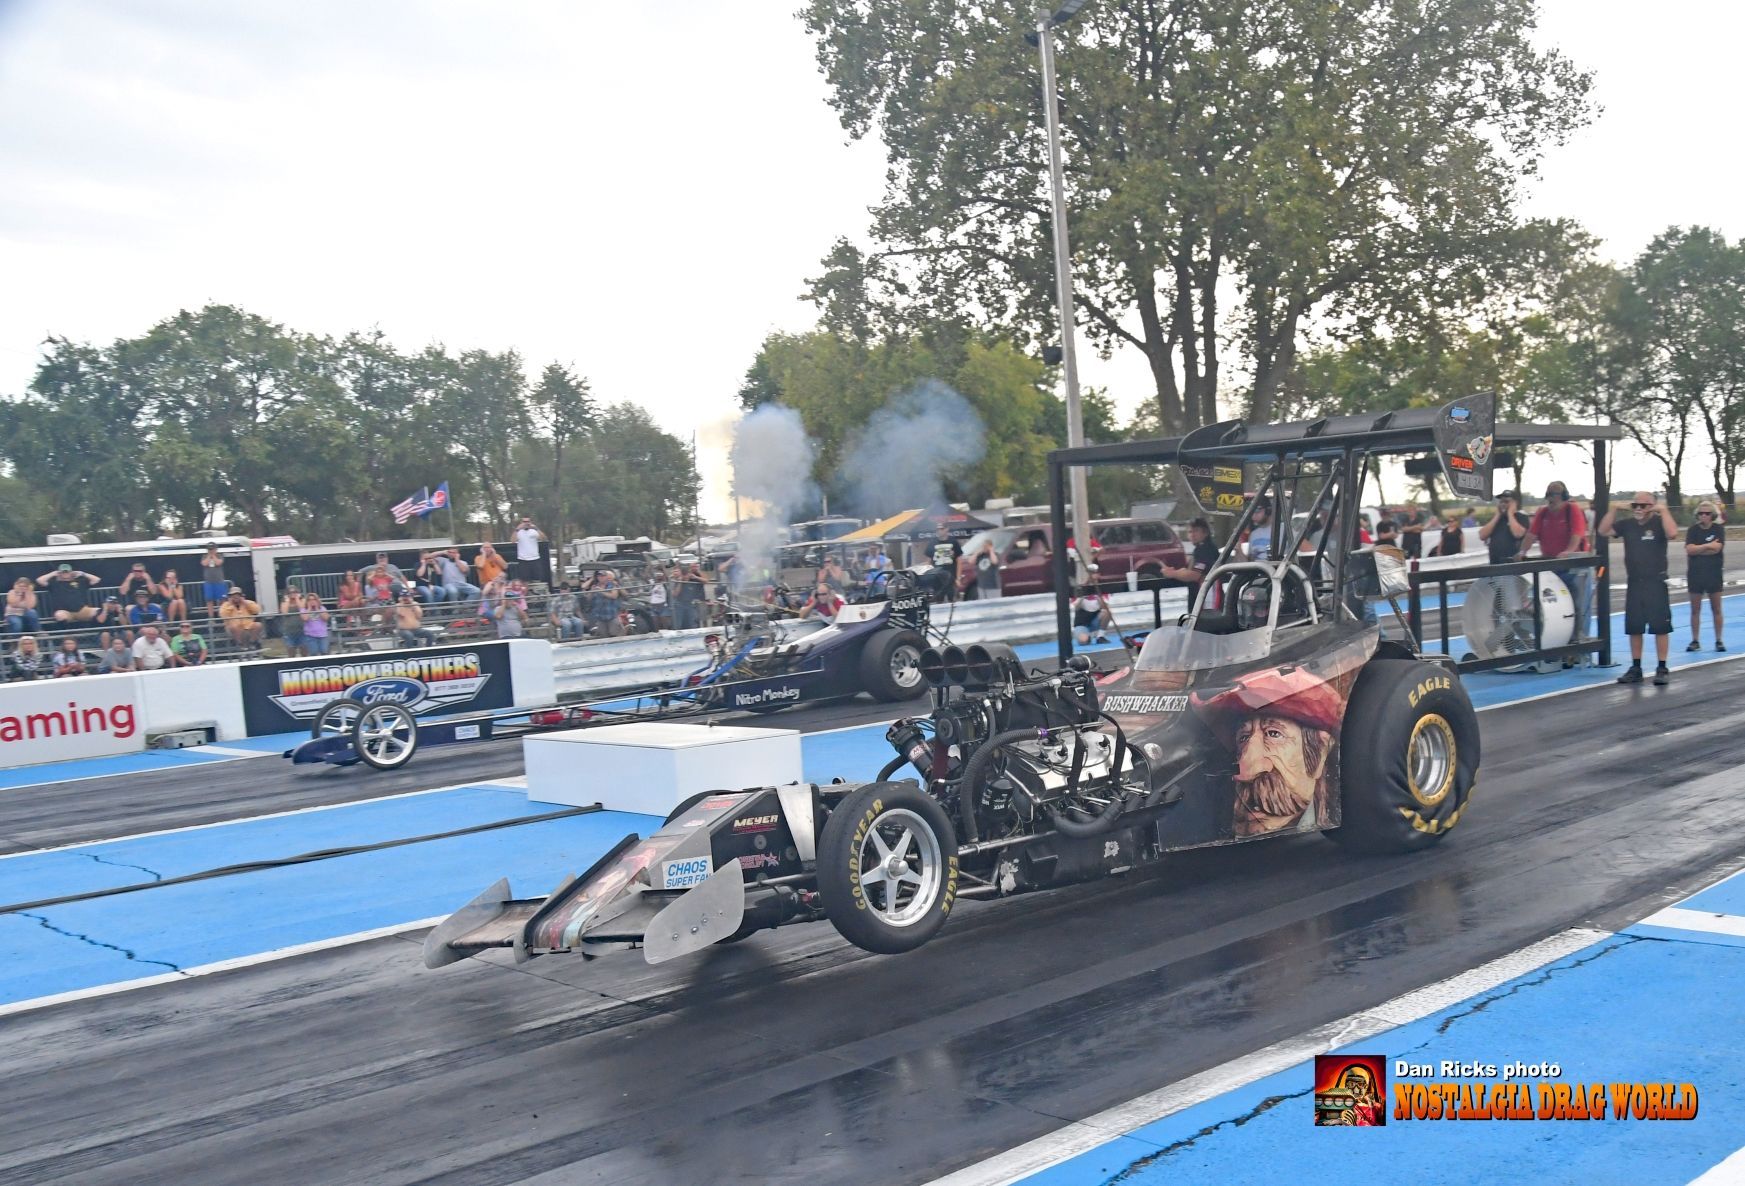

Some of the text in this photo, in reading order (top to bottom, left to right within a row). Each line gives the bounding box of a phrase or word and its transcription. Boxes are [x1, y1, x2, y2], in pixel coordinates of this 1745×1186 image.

[280, 653, 480, 696] MORROW BROTHERS
[362, 683, 408, 705] Ford
[735, 685, 800, 706] Nitro Monkey
[1408, 676, 1451, 708] EAGLE
[1102, 695, 1188, 714] BUSHWHACKER
[0, 702, 135, 742] aming
[733, 814, 779, 828] MEYER
[849, 799, 884, 910] GOODYEAR
[668, 860, 707, 876] CHAOS
[666, 876, 694, 888] SUPER
[941, 856, 959, 914] EAGLE
